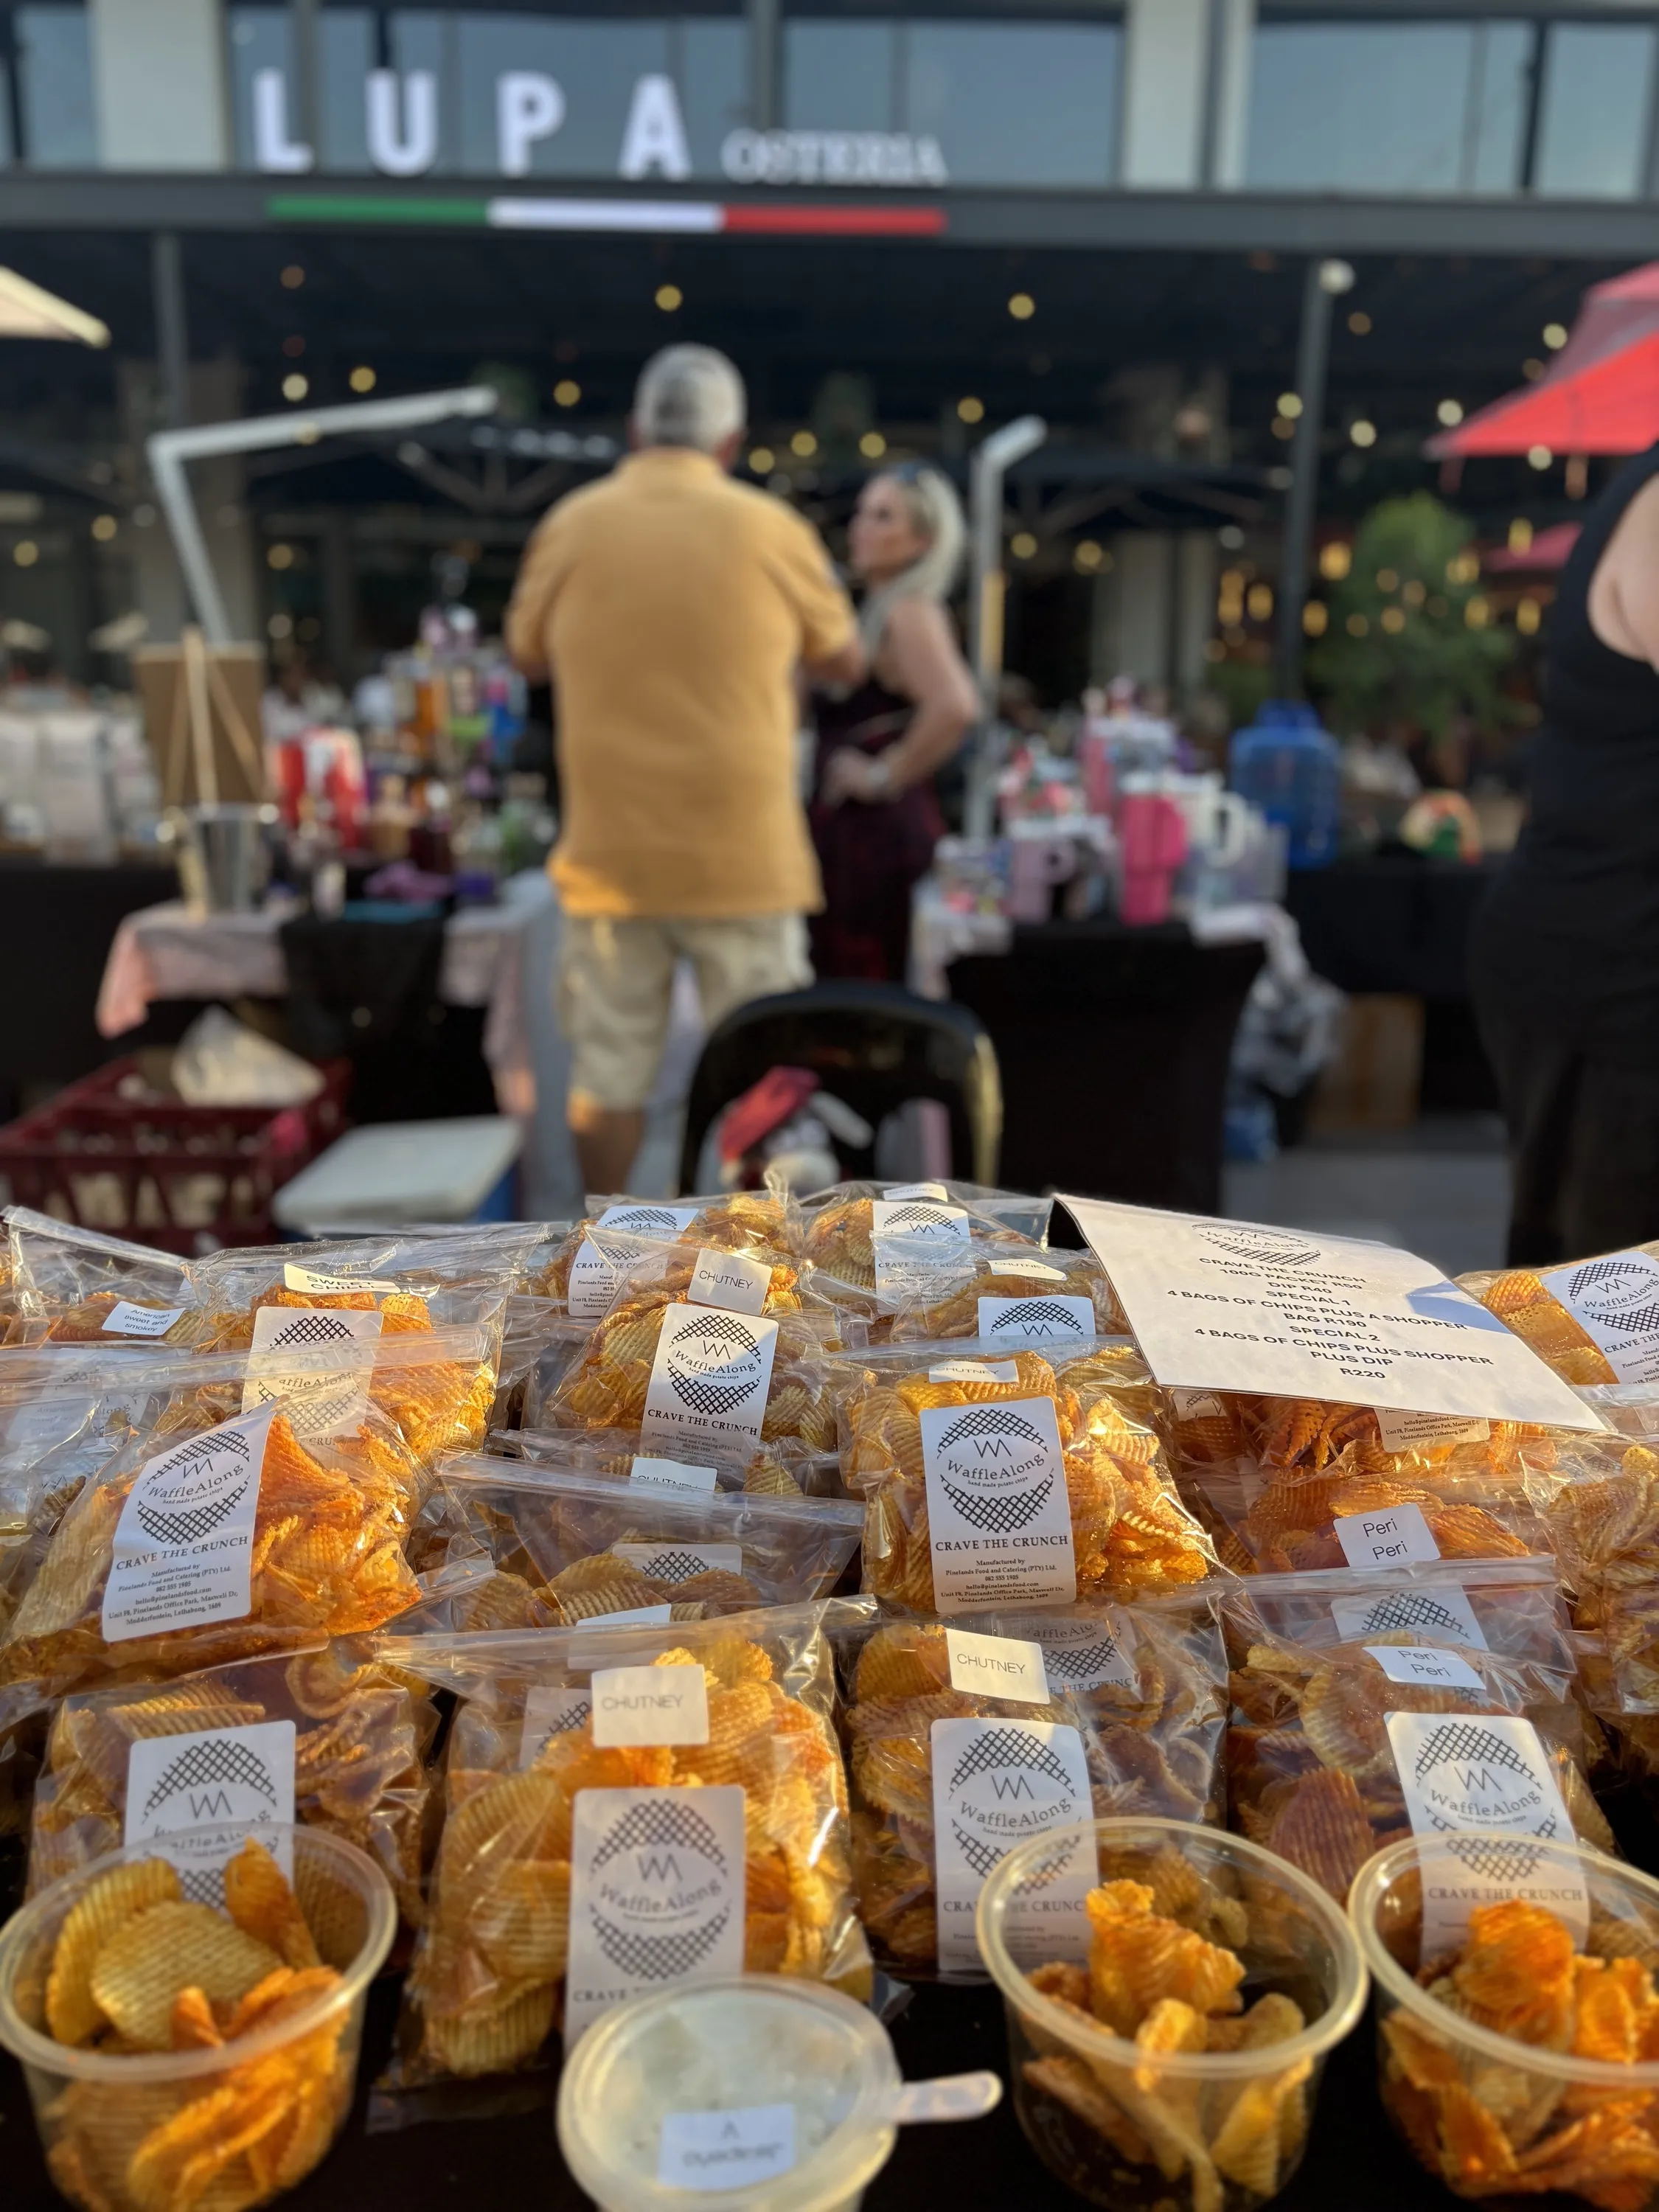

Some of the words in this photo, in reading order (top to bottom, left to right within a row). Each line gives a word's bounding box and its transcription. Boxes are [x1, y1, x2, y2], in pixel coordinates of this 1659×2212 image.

[995, 1262, 1047, 1270] CHUTNEY
[1199, 1258, 1254, 1270] CRAVE
[1258, 1265, 1288, 1274] THE
[1293, 1270, 1366, 1283] CRUNCH
[307, 1276, 372, 1285] SWEET
[699, 1270, 753, 1290] CHUTNEY
[1220, 1269, 1262, 1277] 100G
[1264, 1273, 1328, 1285] PACKET
[1267, 1281, 1296, 1290] DIP
[1301, 1286, 1332, 1294] R40
[1585, 1279, 1659, 1307] WaffleAlong
[1265, 1290, 1340, 1305] SPECIAL
[131, 1310, 170, 1319] American
[1180, 1291, 1230, 1302] BAGS
[1233, 1298, 1257, 1306] OF
[1260, 1301, 1316, 1312] CHIPS
[1318, 1307, 1365, 1318] PLUS
[1382, 1315, 1469, 1330] SHOPPER
[125, 1315, 150, 1324] sweet
[1283, 1313, 1321, 1323] BAG
[1324, 1318, 1367, 1328] R190
[125, 1323, 158, 1332] smokey
[1289, 1326, 1367, 1340] SPECIAL
[1208, 1330, 1260, 1342] BAGS
[1263, 1336, 1289, 1344] OF
[1293, 1339, 1351, 1351] CHIPS
[1354, 1345, 1402, 1357] PLUS
[1404, 1350, 1495, 1365] SHOPPER
[1604, 1339, 1640, 1353] CRAVE
[675, 1350, 757, 1374] WaffleAlong
[1310, 1351, 1359, 1363] PLUS
[1361, 1357, 1394, 1366] DIP
[936, 1366, 999, 1375] CHUTNEY
[1340, 1368, 1386, 1379] R220
[648, 1409, 684, 1422] CRAVE
[687, 1416, 709, 1427] THE
[712, 1420, 757, 1436] CRUNCH
[947, 1454, 1045, 1480] WaffleAlong
[148, 1464, 243, 1498] WaffleAlong
[1363, 1518, 1398, 1537] Peri
[935, 1540, 979, 1551] CRAVE
[983, 1538, 1009, 1548] THE
[1012, 1535, 1068, 1547] CRUNCH
[1372, 1540, 1408, 1560] Peri
[116, 1553, 157, 1571] CRAVE
[161, 1548, 188, 1559] THE
[192, 1536, 248, 1554] CRUNCH
[151, 1565, 191, 1578] Manufactured
[192, 1563, 201, 1571] by
[1028, 1565, 1044, 1573] (PTY)
[118, 1582, 147, 1592] Pinelands
[147, 1578, 162, 1586] Food
[201, 1568, 218, 1577] (PTY)
[133, 1604, 162, 1615] Pinelands
[164, 1601, 184, 1609] Office
[1398, 1649, 1438, 1660] Peri
[957, 1653, 1026, 1674] CHUTNEY
[1411, 1663, 1452, 1677] Peri
[601, 1695, 683, 1711] CHUTNEY
[1430, 1790, 1541, 1817] WaffleAlong
[961, 1798, 1071, 1827] WaffleAlong
[599, 1879, 721, 1913] WaffleAlong
[1428, 1887, 1481, 1900] CRAVE
[1484, 1888, 1513, 1900] THE
[1517, 1888, 1583, 1901] CRUNCH
[573, 1989, 626, 2003] CRAVE
